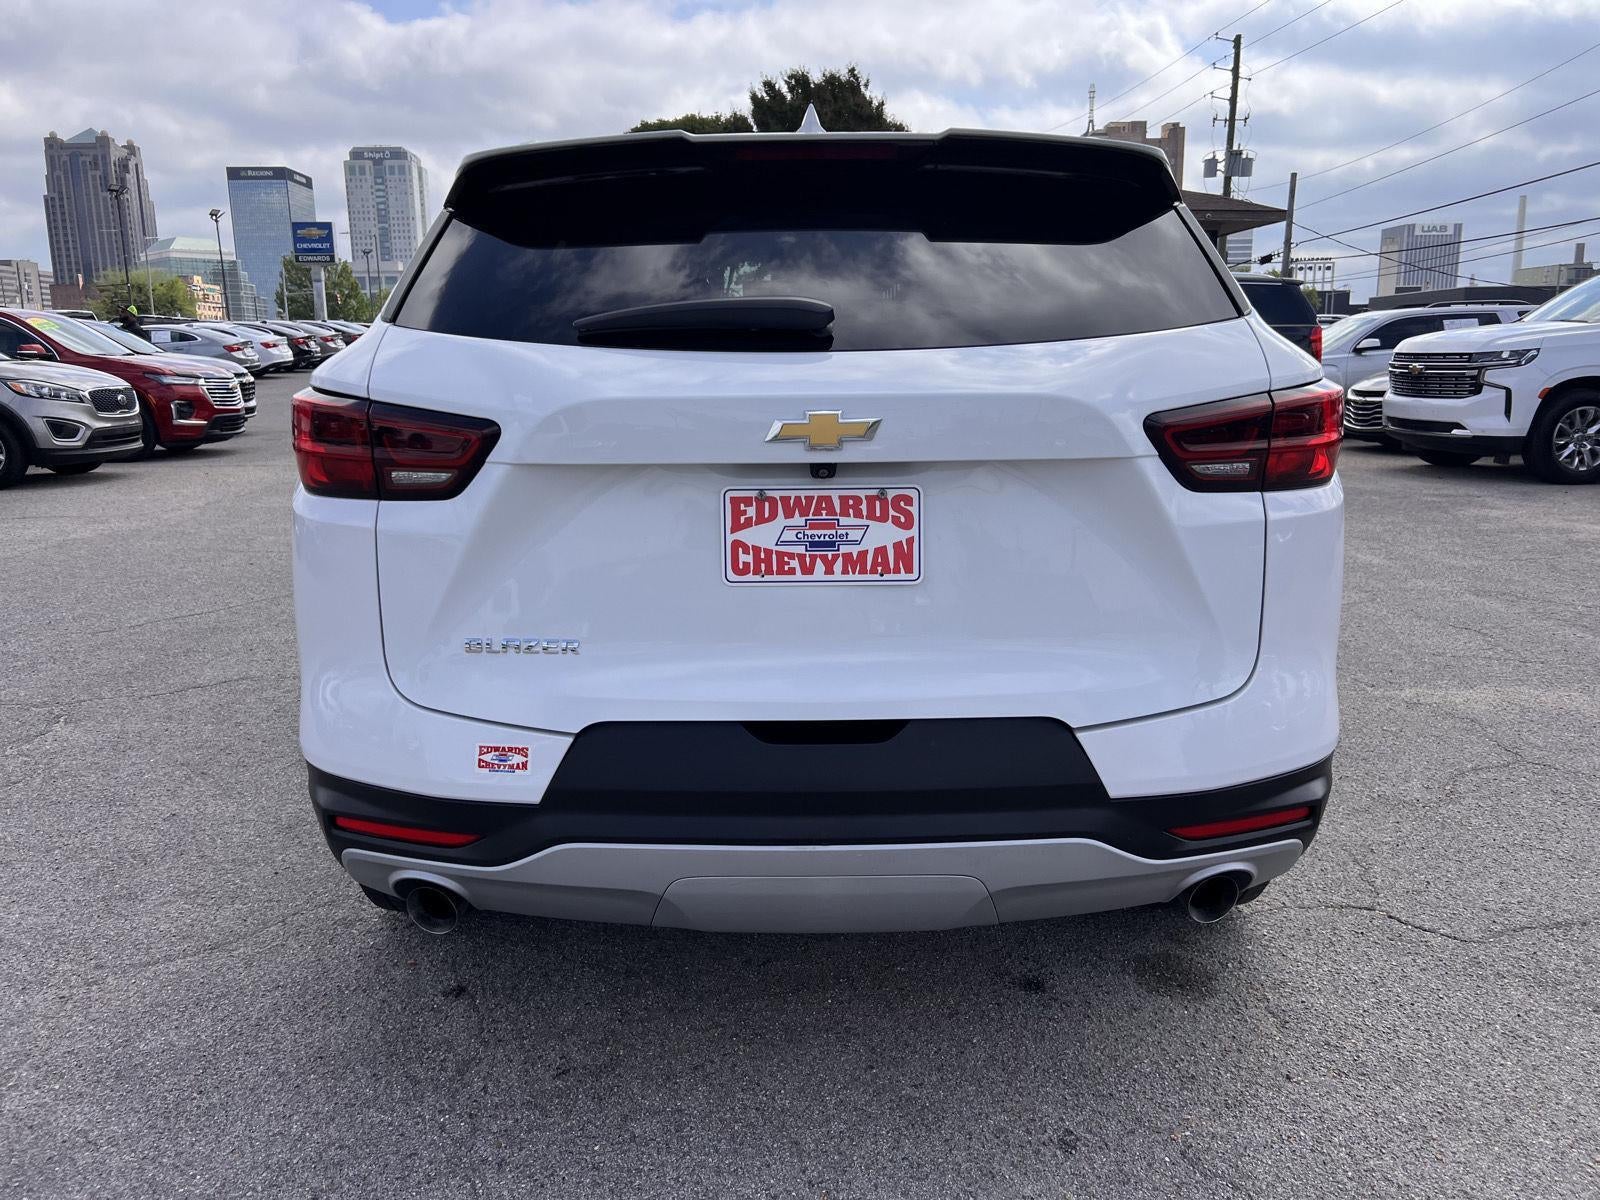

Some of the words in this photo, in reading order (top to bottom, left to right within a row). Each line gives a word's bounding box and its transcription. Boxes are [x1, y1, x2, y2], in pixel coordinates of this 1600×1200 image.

[363, 151, 384, 160] Shipt
[1421, 225, 1448, 233] UAB
[729, 494, 915, 534] EDWARDS
[794, 530, 850, 541] Chevrolet
[730, 535, 915, 577] CHEVYMAN
[464, 638, 580, 655] BLAZER
[478, 745, 529, 759] EDWARDS
[477, 758, 528, 771] CHEVYMAN
